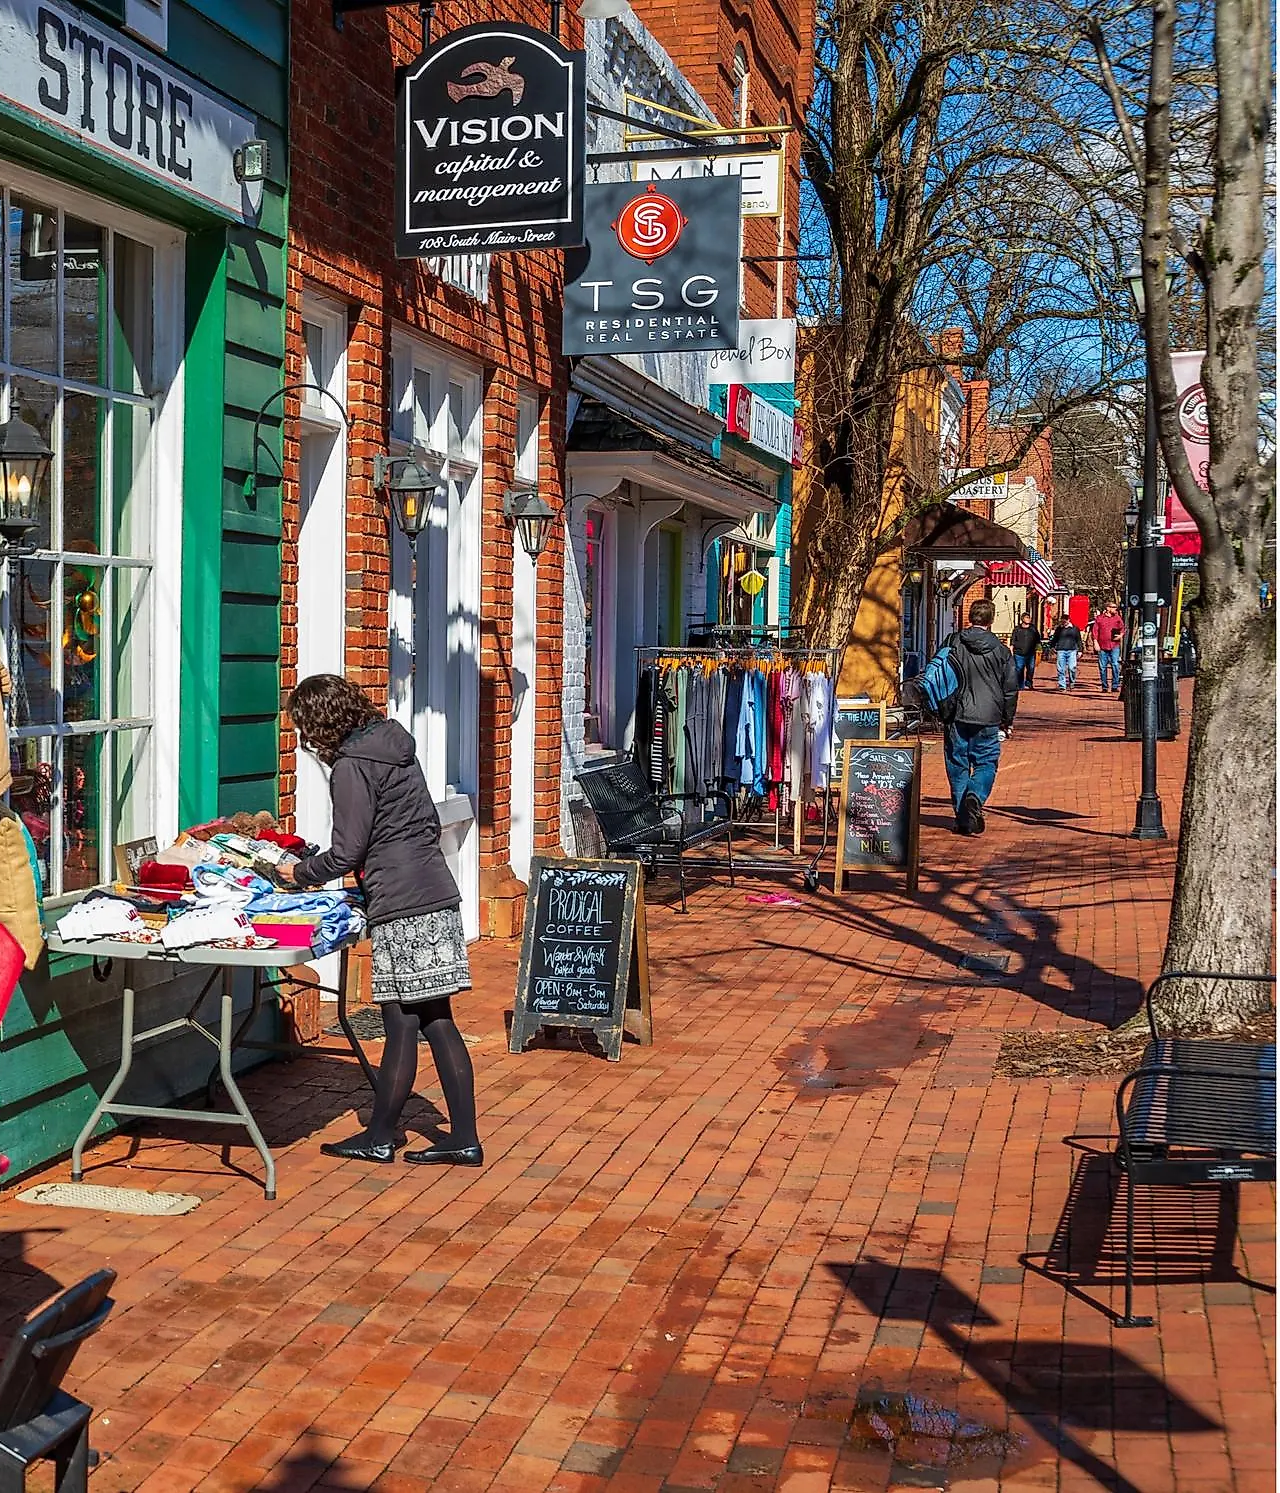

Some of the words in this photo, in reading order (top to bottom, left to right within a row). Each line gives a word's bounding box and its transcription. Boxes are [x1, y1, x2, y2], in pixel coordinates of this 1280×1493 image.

[36, 6, 193, 182] STORE
[413, 111, 565, 150] VISION
[434, 147, 517, 182] capital
[518, 150, 544, 168] &
[412, 176, 563, 207] management
[419, 236, 443, 250] 108
[442, 231, 481, 248] South
[481, 230, 517, 246] Main
[517, 228, 557, 244] Street
[580, 274, 719, 312] TSG
[585, 315, 720, 331] RESIDENTIAL
[585, 333, 633, 344] REAL
[648, 328, 719, 341] ESTATE
[758, 336, 793, 361] Box
[860, 839, 892, 853] MINE
[548, 887, 613, 924] PRODIGAL
[545, 923, 603, 937] COFFEE
[554, 962, 574, 977] baked
[576, 963, 596, 979] goods
